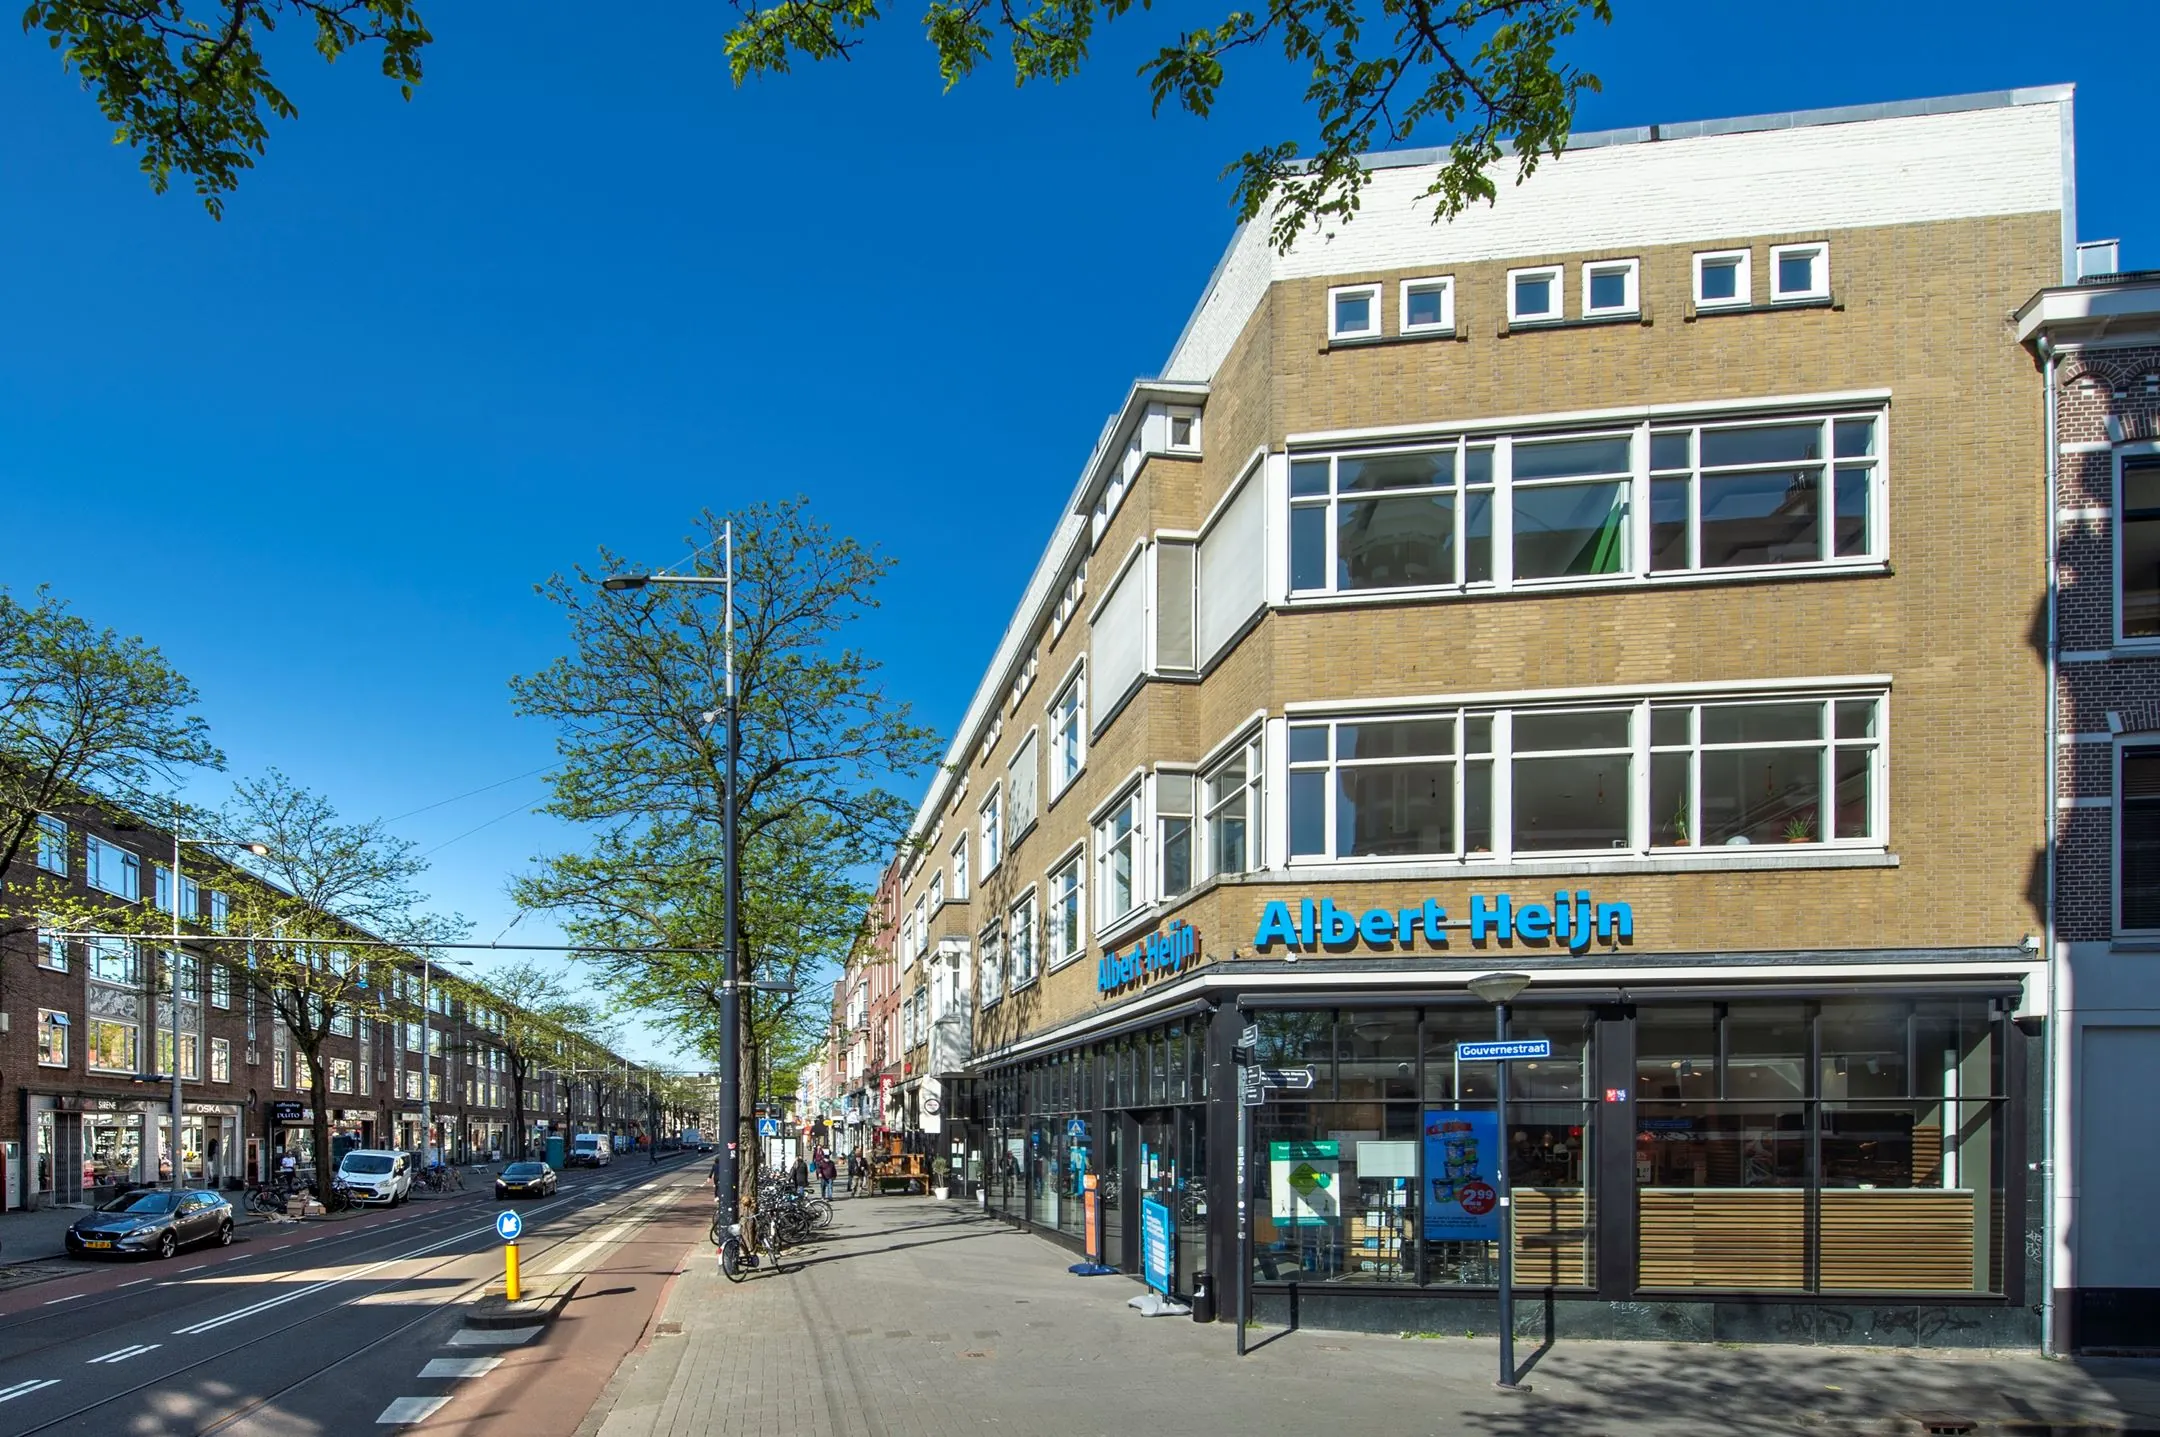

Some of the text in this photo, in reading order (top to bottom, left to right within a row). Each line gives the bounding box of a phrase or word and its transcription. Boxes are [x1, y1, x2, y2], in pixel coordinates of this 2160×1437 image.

[1254, 889, 1634, 949] Albert Heijn
[1097, 918, 1196, 993] Albert Heijn
[1462, 1042, 1546, 1057] Gouvernestraat
[196, 1104, 221, 1113] OSKA
